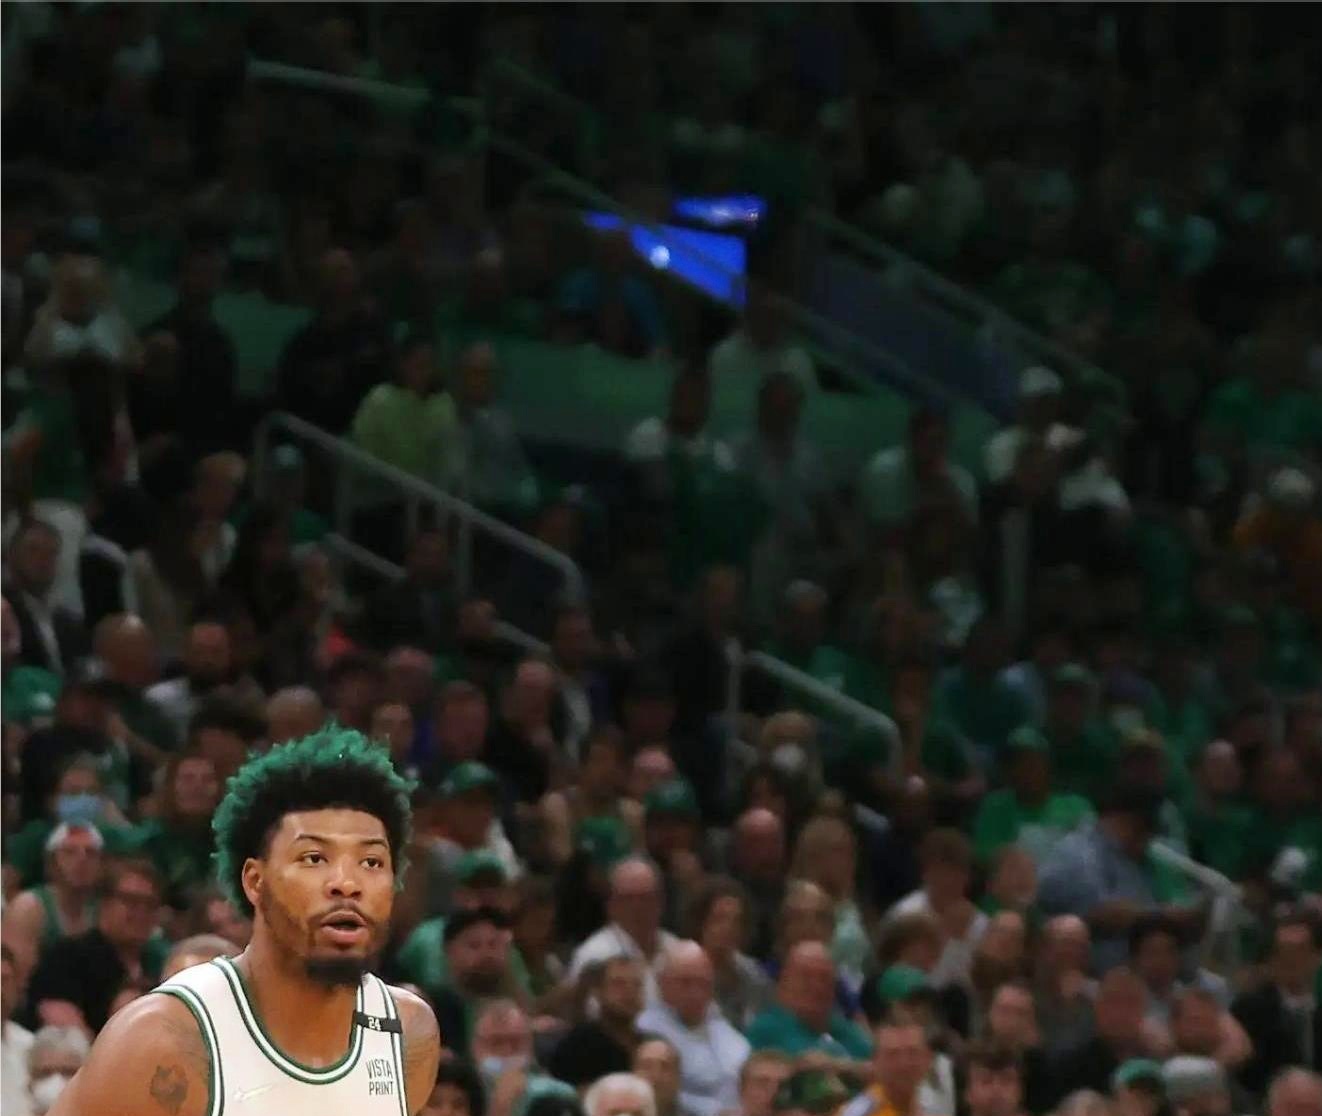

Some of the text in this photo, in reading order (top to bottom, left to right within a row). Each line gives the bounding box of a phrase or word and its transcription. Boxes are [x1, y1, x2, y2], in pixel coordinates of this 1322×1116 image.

[367, 1016, 382, 1031] 24
[366, 1058, 394, 1080] VISTA
[368, 1081, 394, 1096] PRINT
